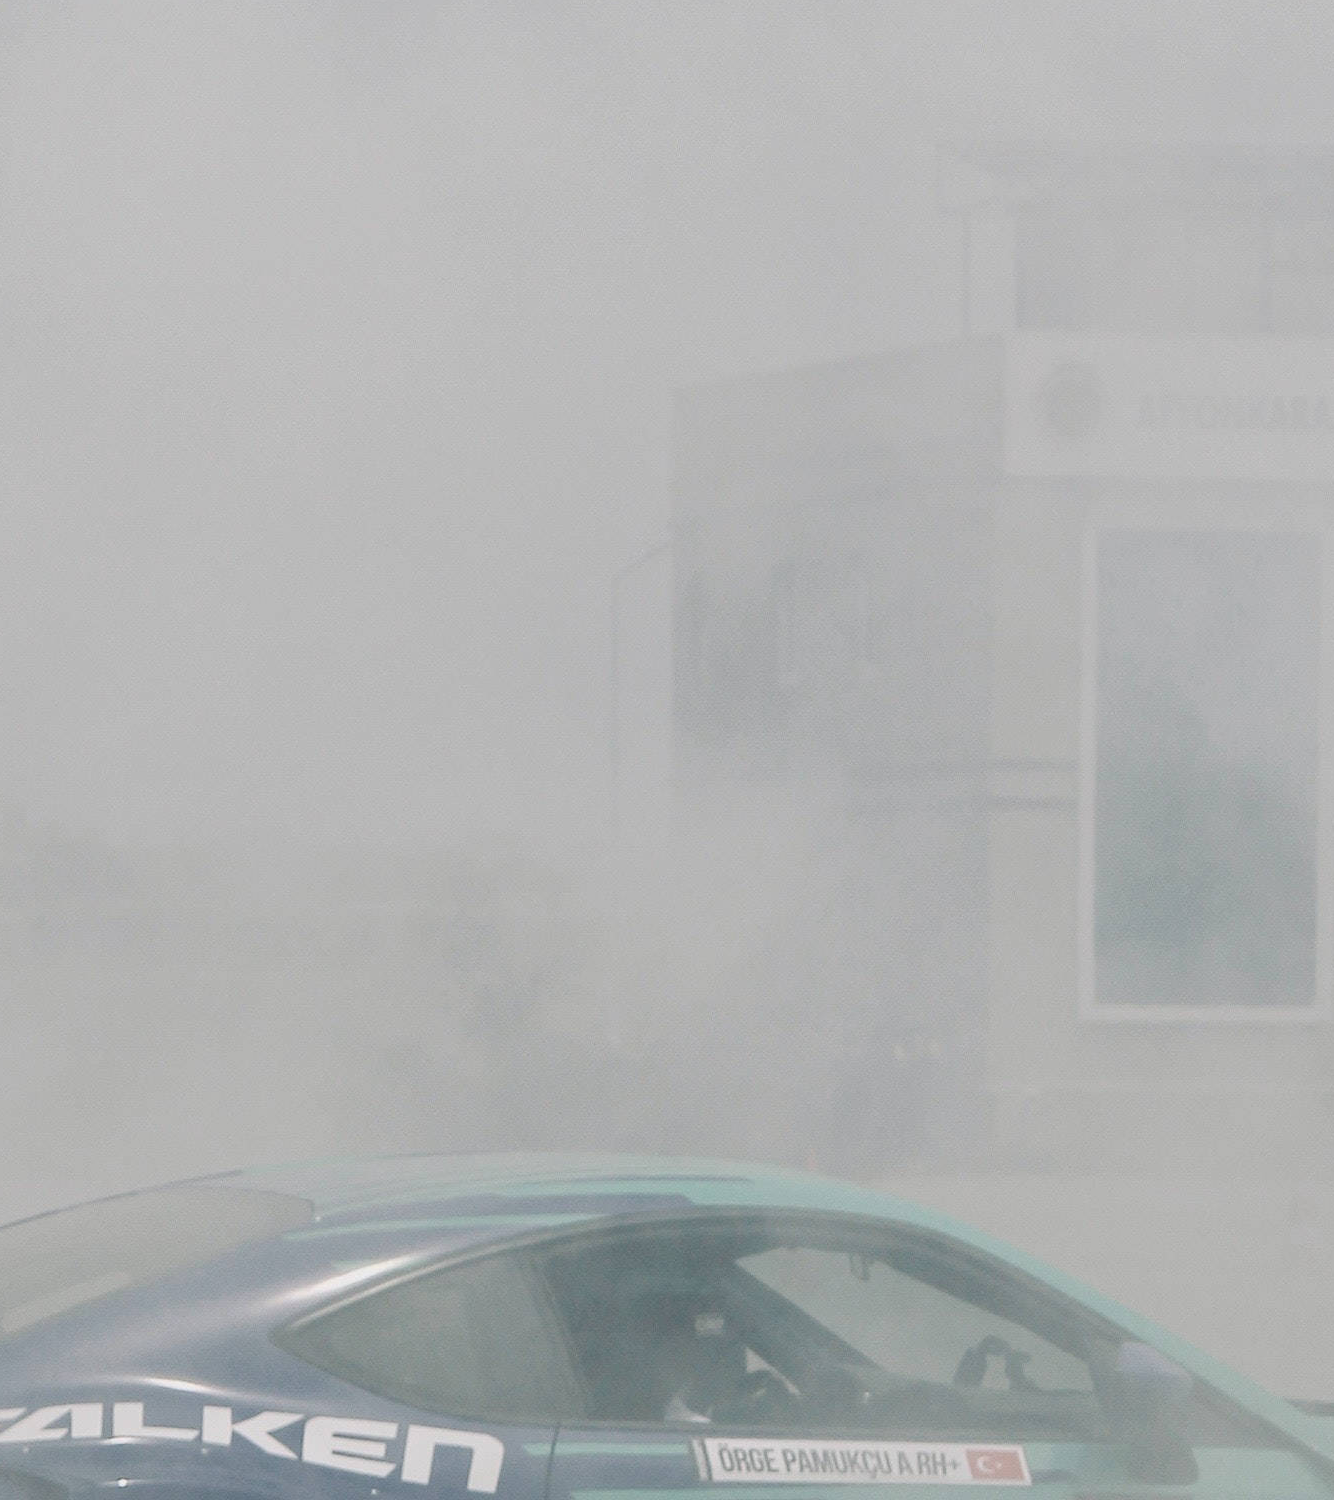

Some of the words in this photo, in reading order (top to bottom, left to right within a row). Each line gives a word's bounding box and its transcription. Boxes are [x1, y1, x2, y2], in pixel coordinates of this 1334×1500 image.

[718, 1443, 779, 1473] ÖRGE
[782, 1447, 892, 1478] PAMUKÇU
[897, 1450, 914, 1474] A
[917, 1451, 960, 1476] RH+
